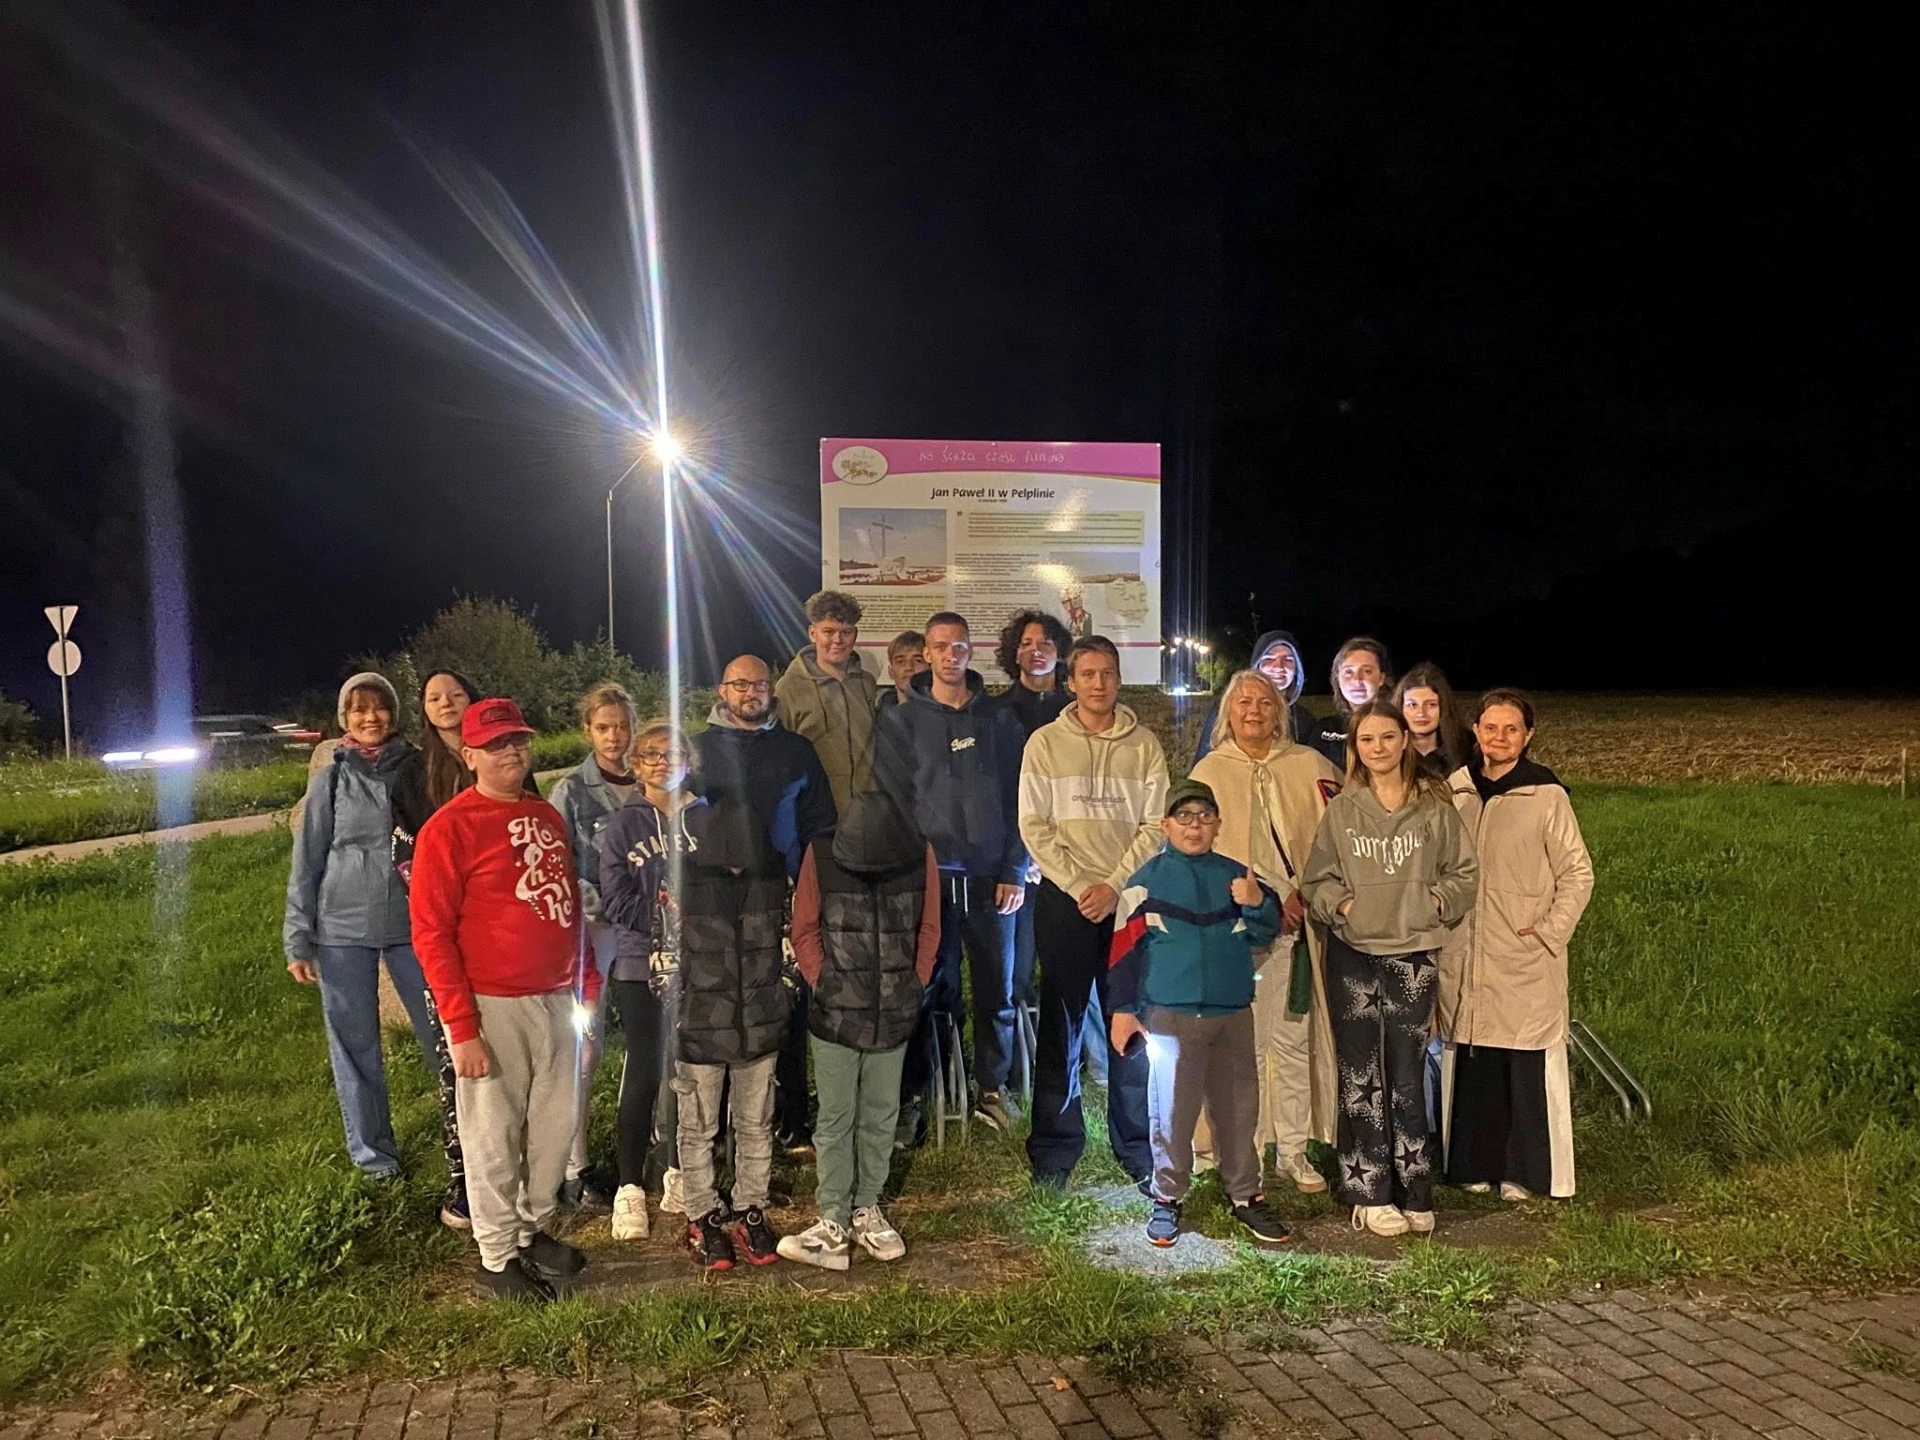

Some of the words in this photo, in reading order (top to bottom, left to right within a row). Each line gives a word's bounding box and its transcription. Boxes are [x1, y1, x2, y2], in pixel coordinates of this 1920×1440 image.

[931, 487, 949, 499] Jan
[988, 488, 995, 498] II
[1011, 488, 1055, 500] Pelplinie
